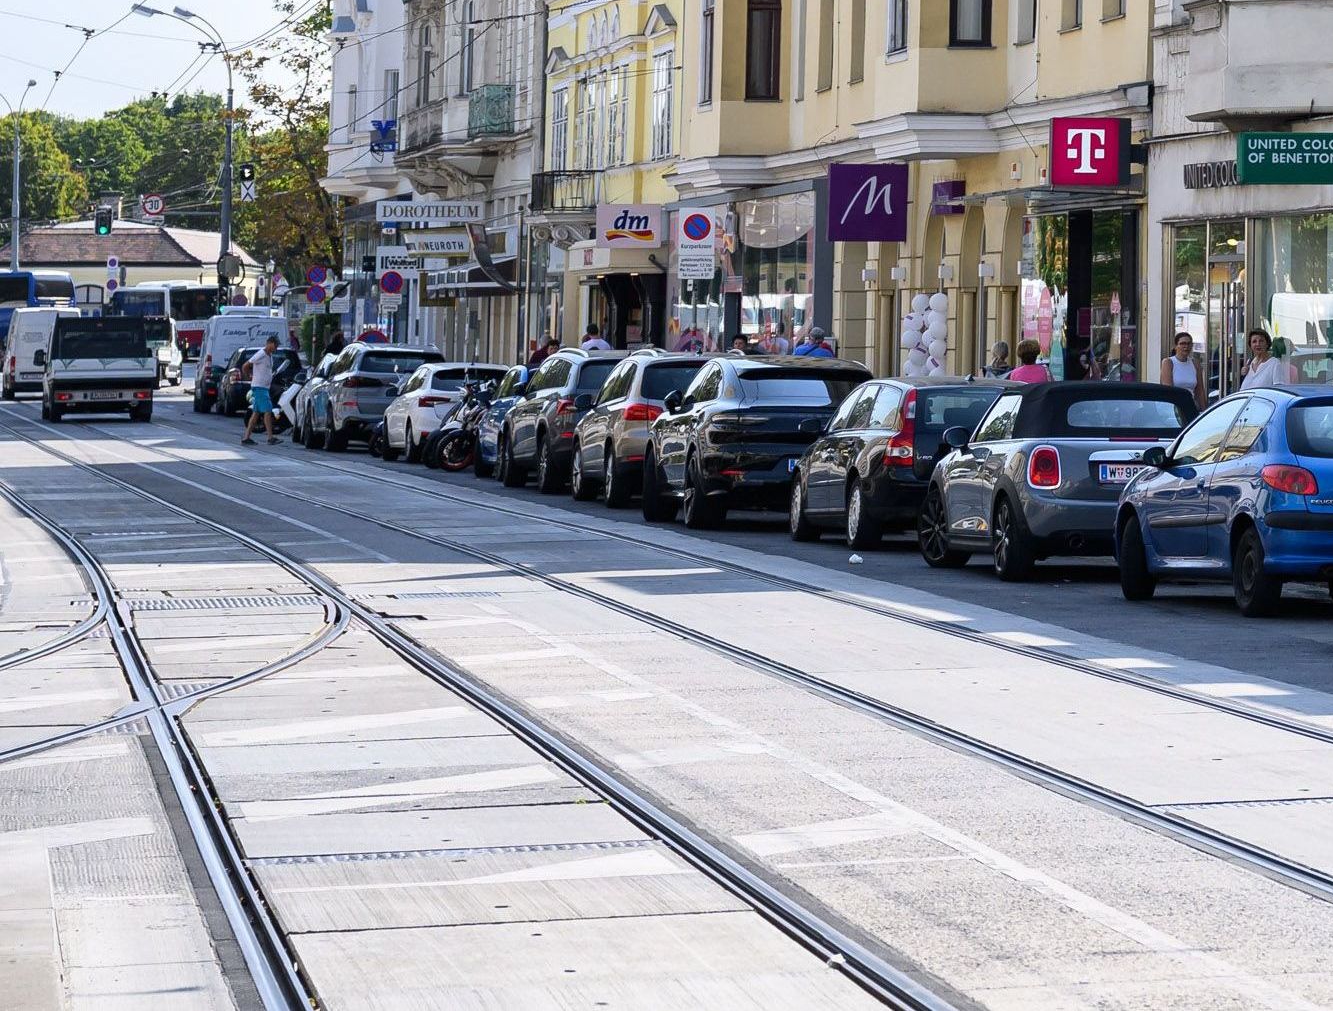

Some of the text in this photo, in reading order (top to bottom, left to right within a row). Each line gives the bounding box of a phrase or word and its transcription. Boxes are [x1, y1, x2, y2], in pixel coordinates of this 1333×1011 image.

[1248, 139, 1297, 150] UNITED
[1248, 153, 1265, 163] OF
[1183, 163, 1212, 188] UNITED
[147, 199, 160, 210] 30
[383, 205, 479, 218] DOROTHEUM
[614, 209, 649, 230] dm
[1109, 467, 1117, 478] W
